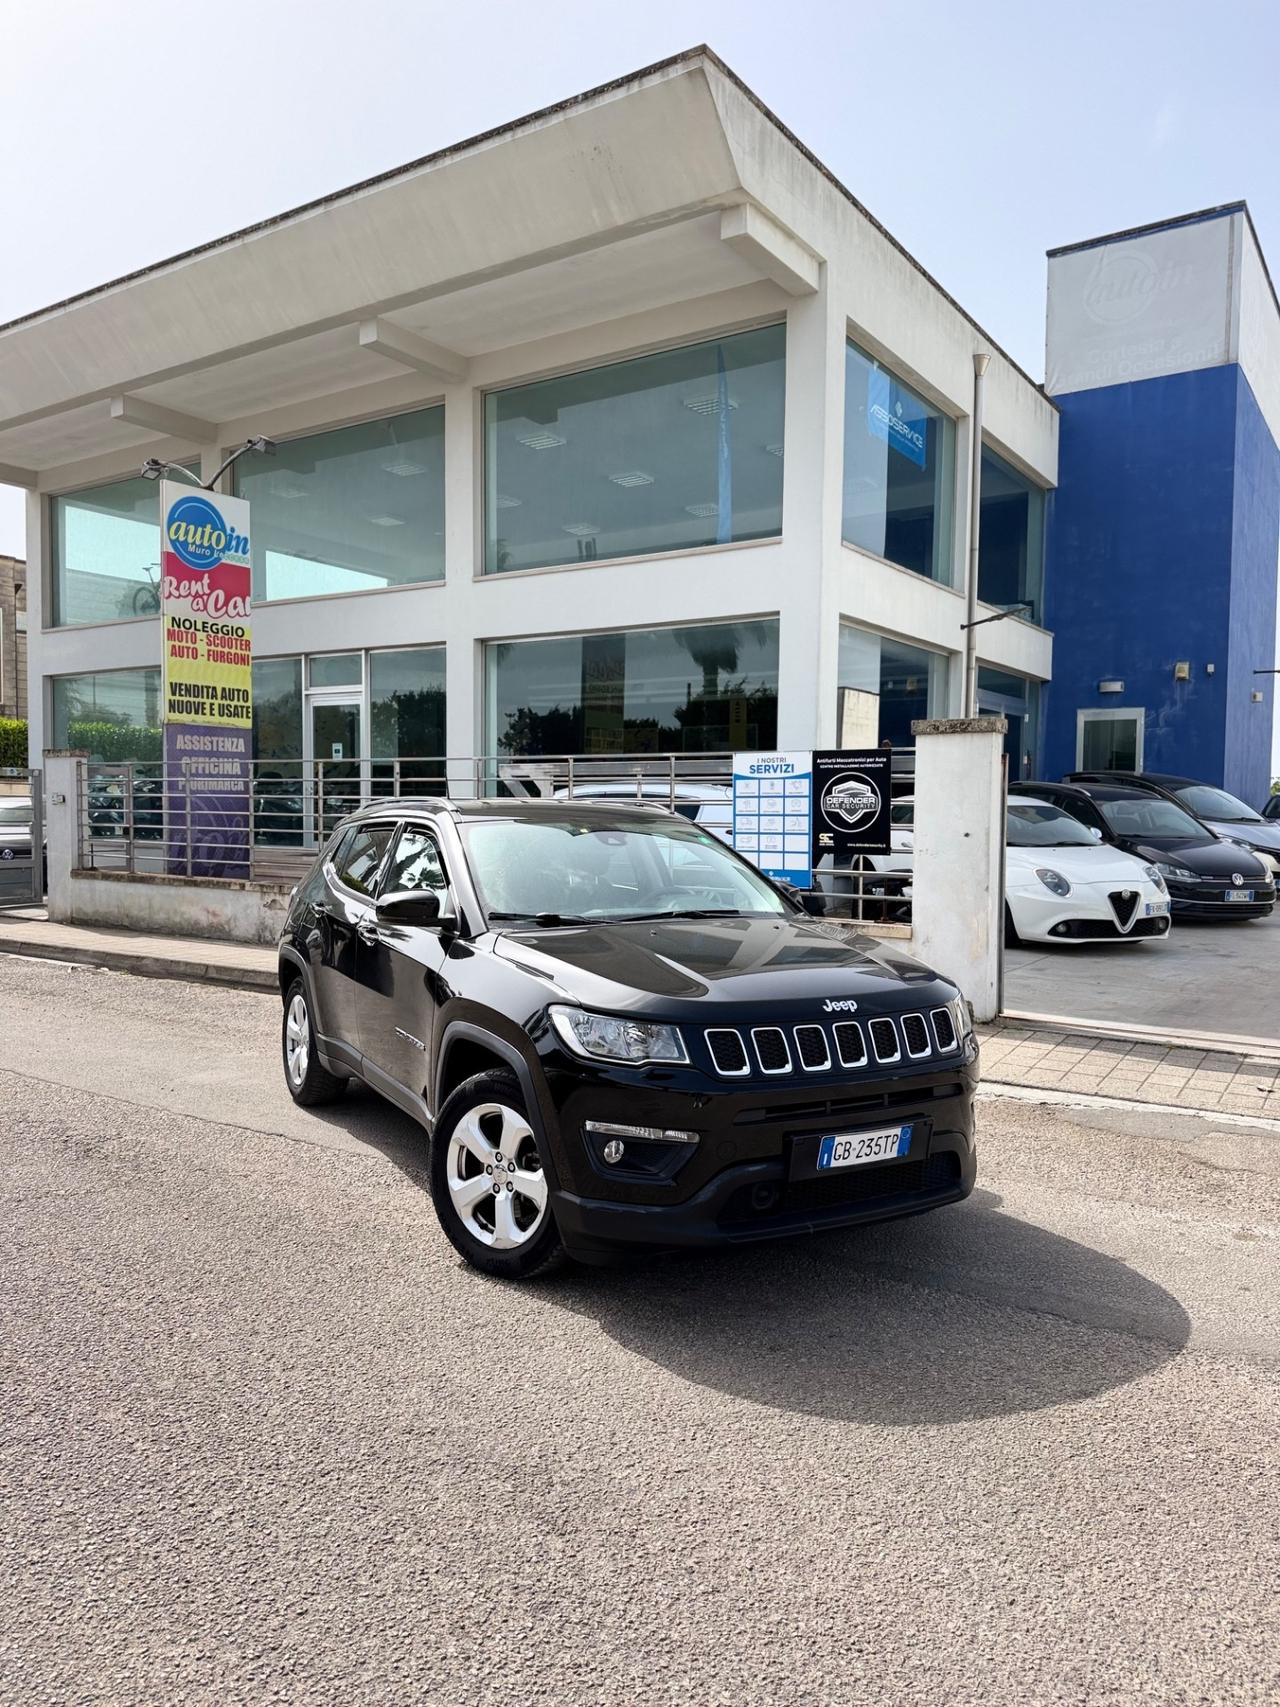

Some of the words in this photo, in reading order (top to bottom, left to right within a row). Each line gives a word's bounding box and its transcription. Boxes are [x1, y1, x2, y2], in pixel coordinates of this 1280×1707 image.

[187, 544, 211, 556] Muro
[164, 573, 211, 598] Rent
[171, 616, 245, 638] NOLEGGIO
[167, 628, 198, 645] MOTO
[206, 633, 251, 652] SCOOTER
[170, 644, 198, 660] AUTO
[207, 648, 250, 666] FURGONI
[170, 681, 218, 700] VENDITA
[220, 687, 249, 703] AUTO
[168, 699, 206, 716] NUOVE
[209, 702, 216, 717] E
[218, 702, 251, 719] USATE
[176, 734, 245, 752] ASSISTENZA
[749, 763, 795, 774] SERVIZI
[823, 999, 858, 1012] Jeep
